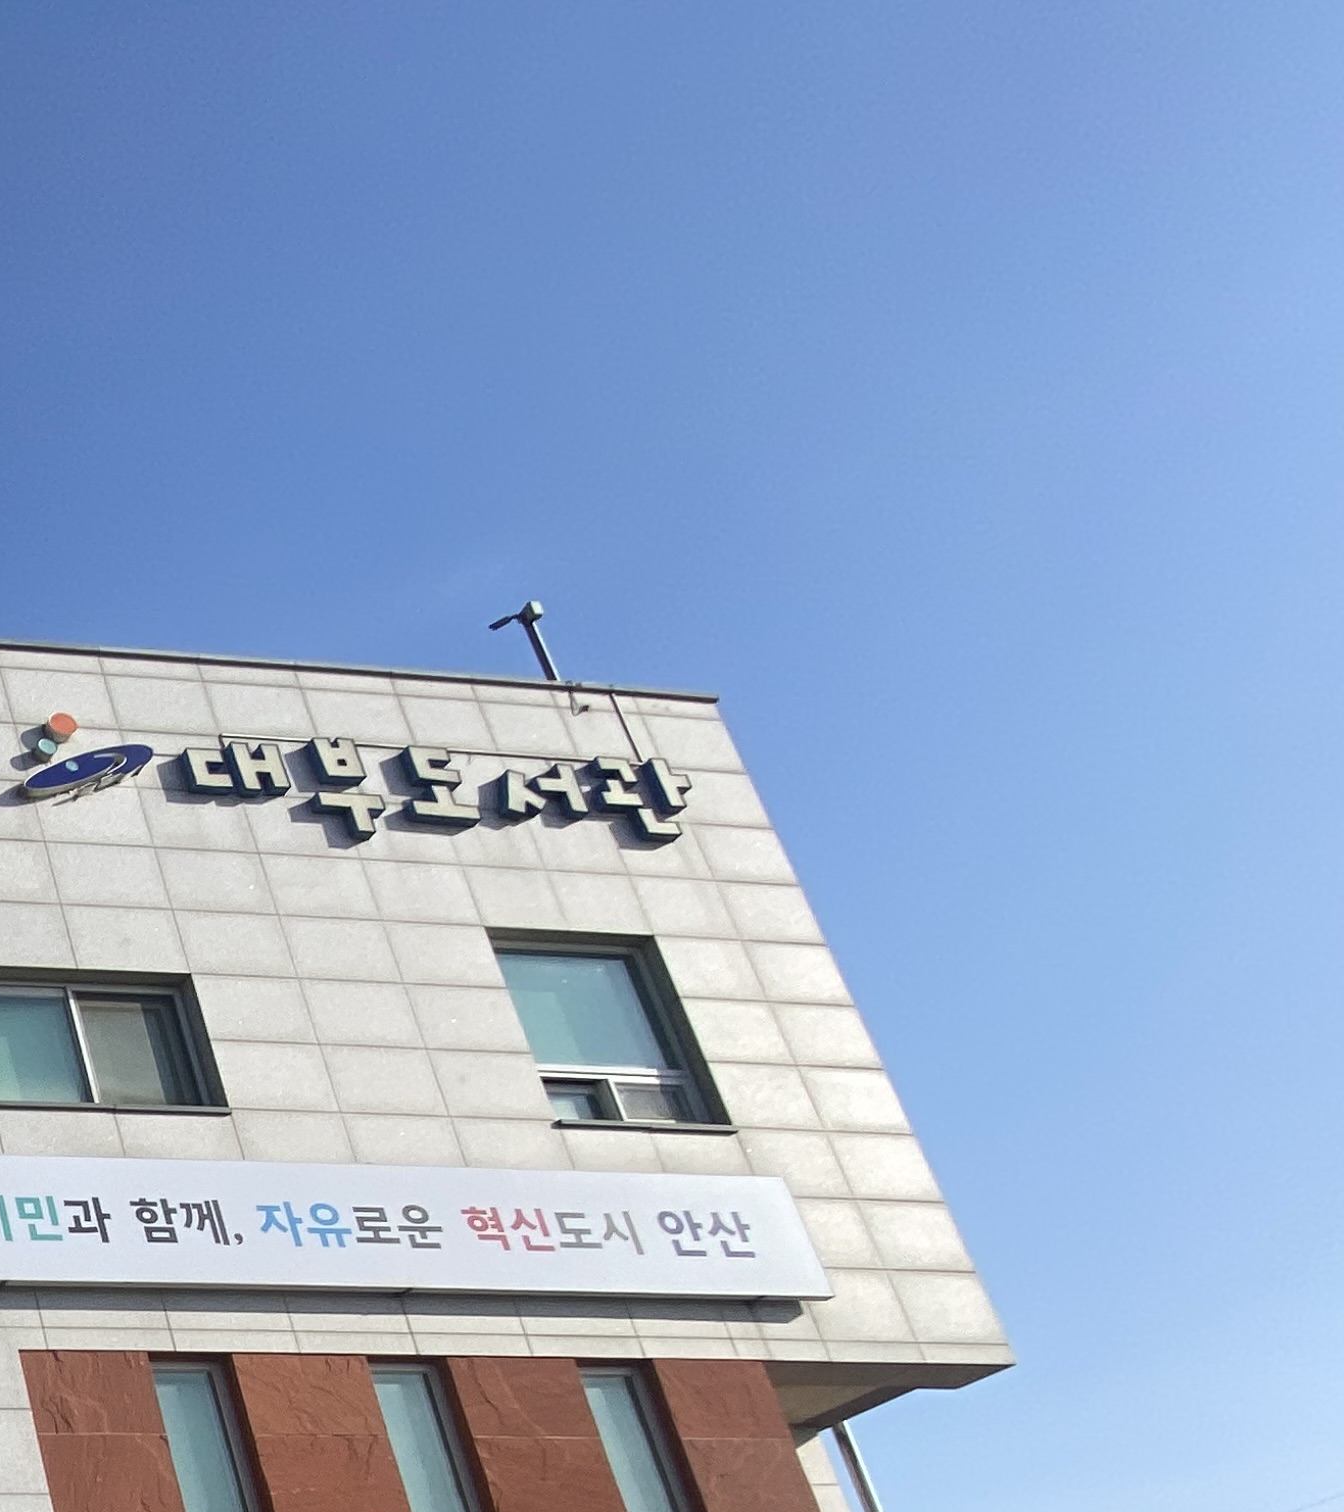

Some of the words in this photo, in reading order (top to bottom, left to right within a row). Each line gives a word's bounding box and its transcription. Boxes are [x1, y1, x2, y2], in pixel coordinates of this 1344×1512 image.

[181, 736, 694, 842] 대부도서관
[130, 1197, 245, 1248] 함께,
[256, 1201, 444, 1251] 자유로운
[460, 1205, 645, 1256] 혁신도시
[658, 1210, 756, 1259] 안산
